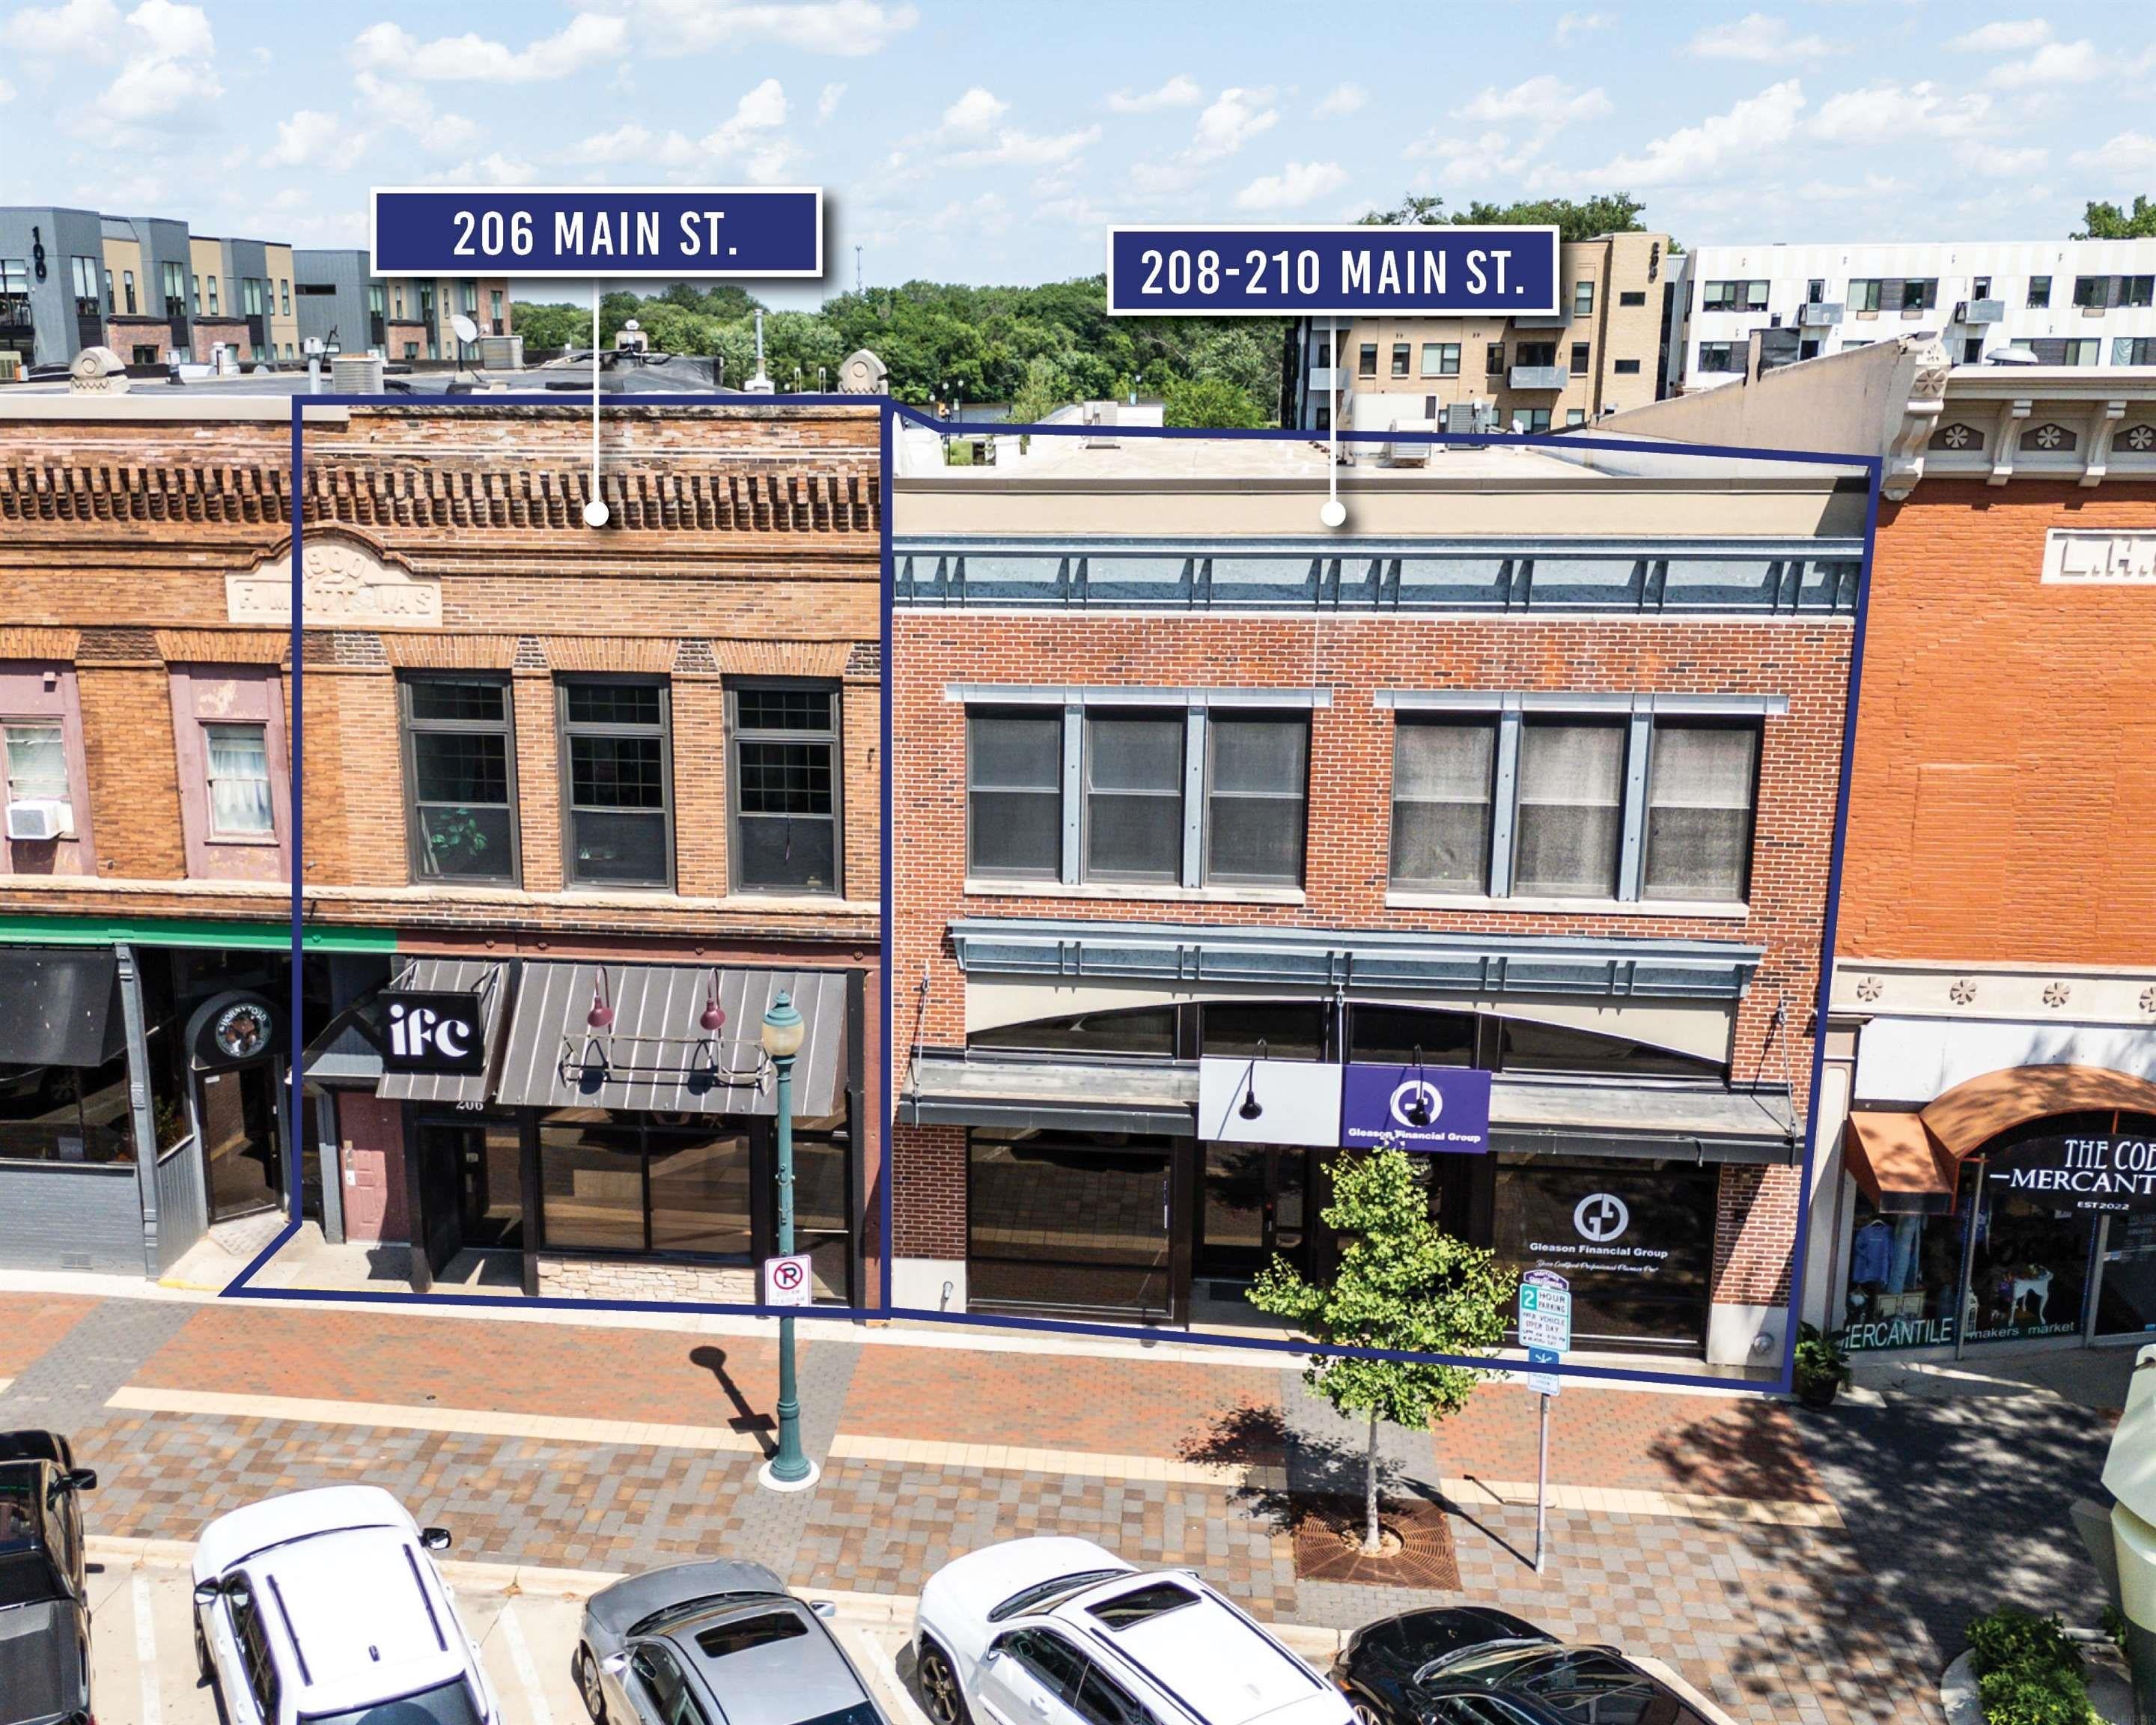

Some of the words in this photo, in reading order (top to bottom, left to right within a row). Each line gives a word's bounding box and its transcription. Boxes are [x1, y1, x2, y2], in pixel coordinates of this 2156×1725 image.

[32, 226, 46, 279] 100
[389, 1004, 469, 1057] ifc
[1348, 1128, 1393, 1140] Gleason
[1394, 1129, 1446, 1141] Financial
[1448, 1132, 1482, 1143] Group
[2064, 1140, 2109, 1169] THE
[2010, 1168, 2156, 1194] MERCANT
[1529, 1242, 1576, 1253] Gleason
[1579, 1245, 1631, 1257] Financial
[1634, 1247, 1669, 1259] Group
[1523, 1290, 1535, 1307] 2
[1539, 1292, 1565, 1303] HOUR
[1538, 1301, 1565, 1313] PARKING
[2027, 1321, 2075, 1335] market
